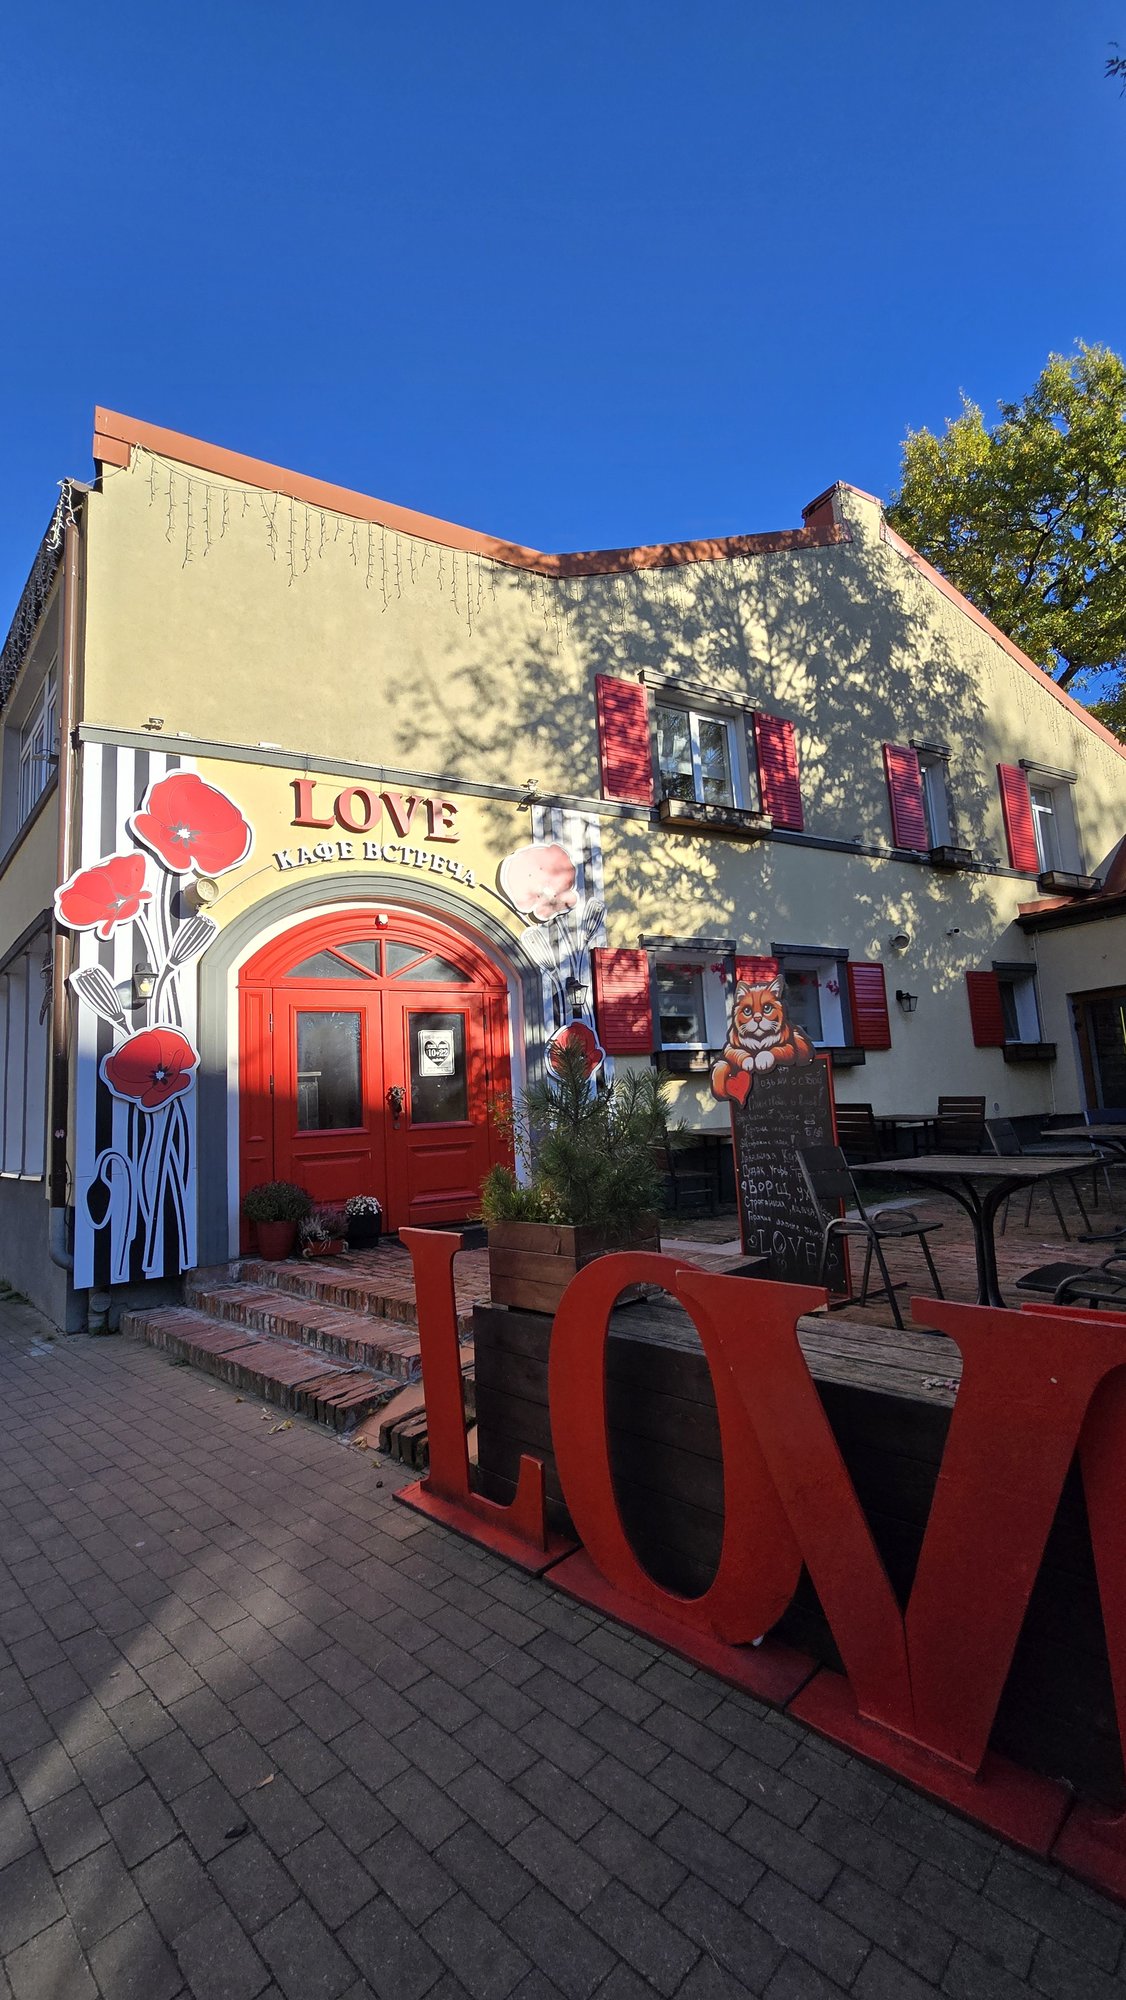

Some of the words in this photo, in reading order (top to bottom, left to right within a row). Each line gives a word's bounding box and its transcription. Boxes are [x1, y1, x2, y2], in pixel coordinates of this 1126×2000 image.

[290, 778, 460, 843] LOVE
[273, 842, 354, 871] КАФЕ
[363, 842, 477, 888] ВСТРЕЧА
[756, 1229, 817, 1266] LOVE
[398, 1226, 1126, 1830] LOV
